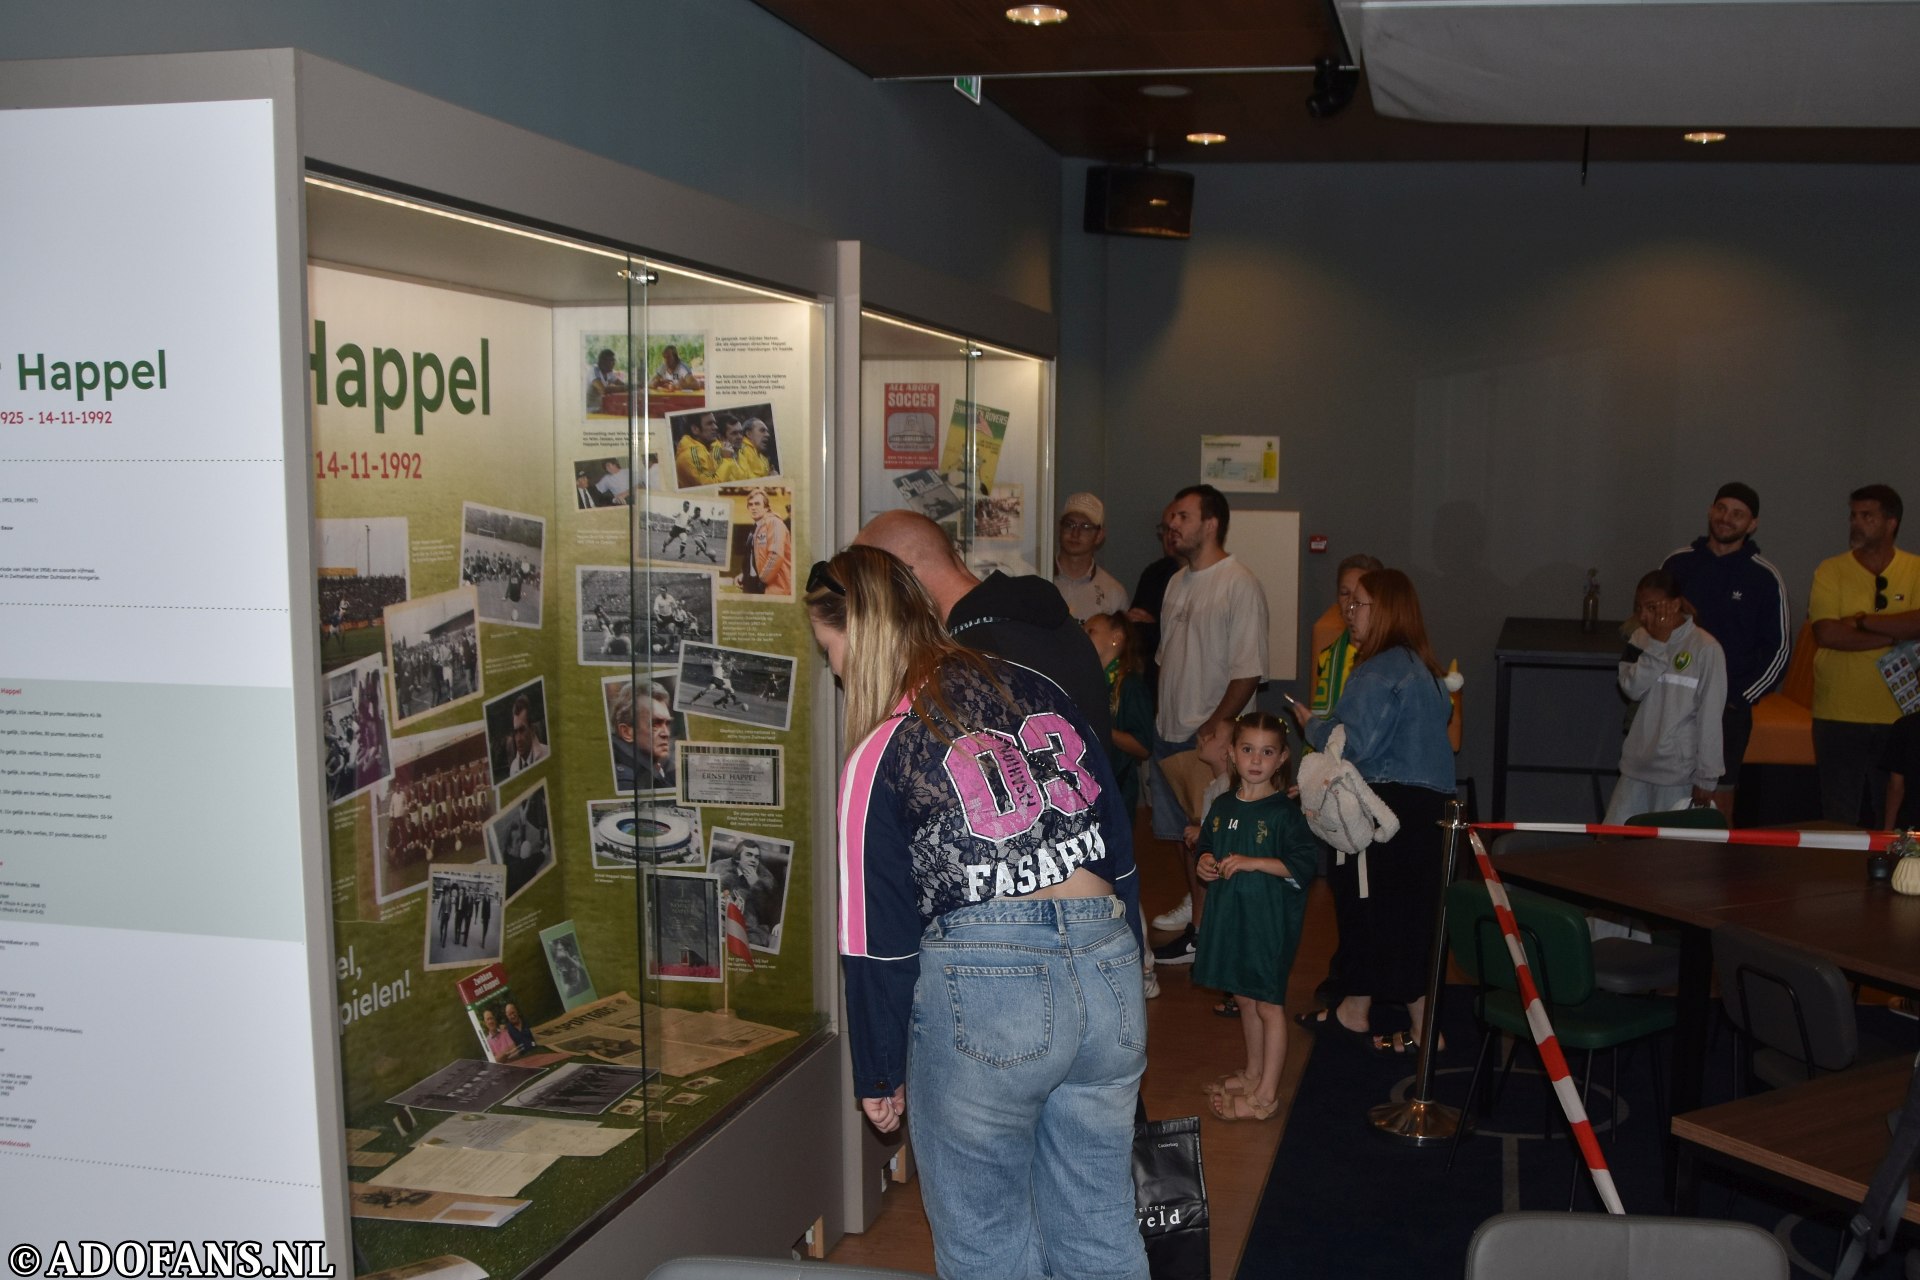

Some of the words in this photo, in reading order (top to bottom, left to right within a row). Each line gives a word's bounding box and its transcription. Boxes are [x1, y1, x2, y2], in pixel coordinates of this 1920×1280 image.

[17, 349, 167, 402] Happel
[310, 319, 490, 436] Happel
[888, 392, 936, 408] SOCCER
[38, 411, 113, 425] 14-11-1992
[315, 450, 423, 480] 14-11-1992
[943, 712, 1102, 842] 03
[1228, 819, 1239, 830] 14
[1134, 1205, 1166, 1214] EITEN
